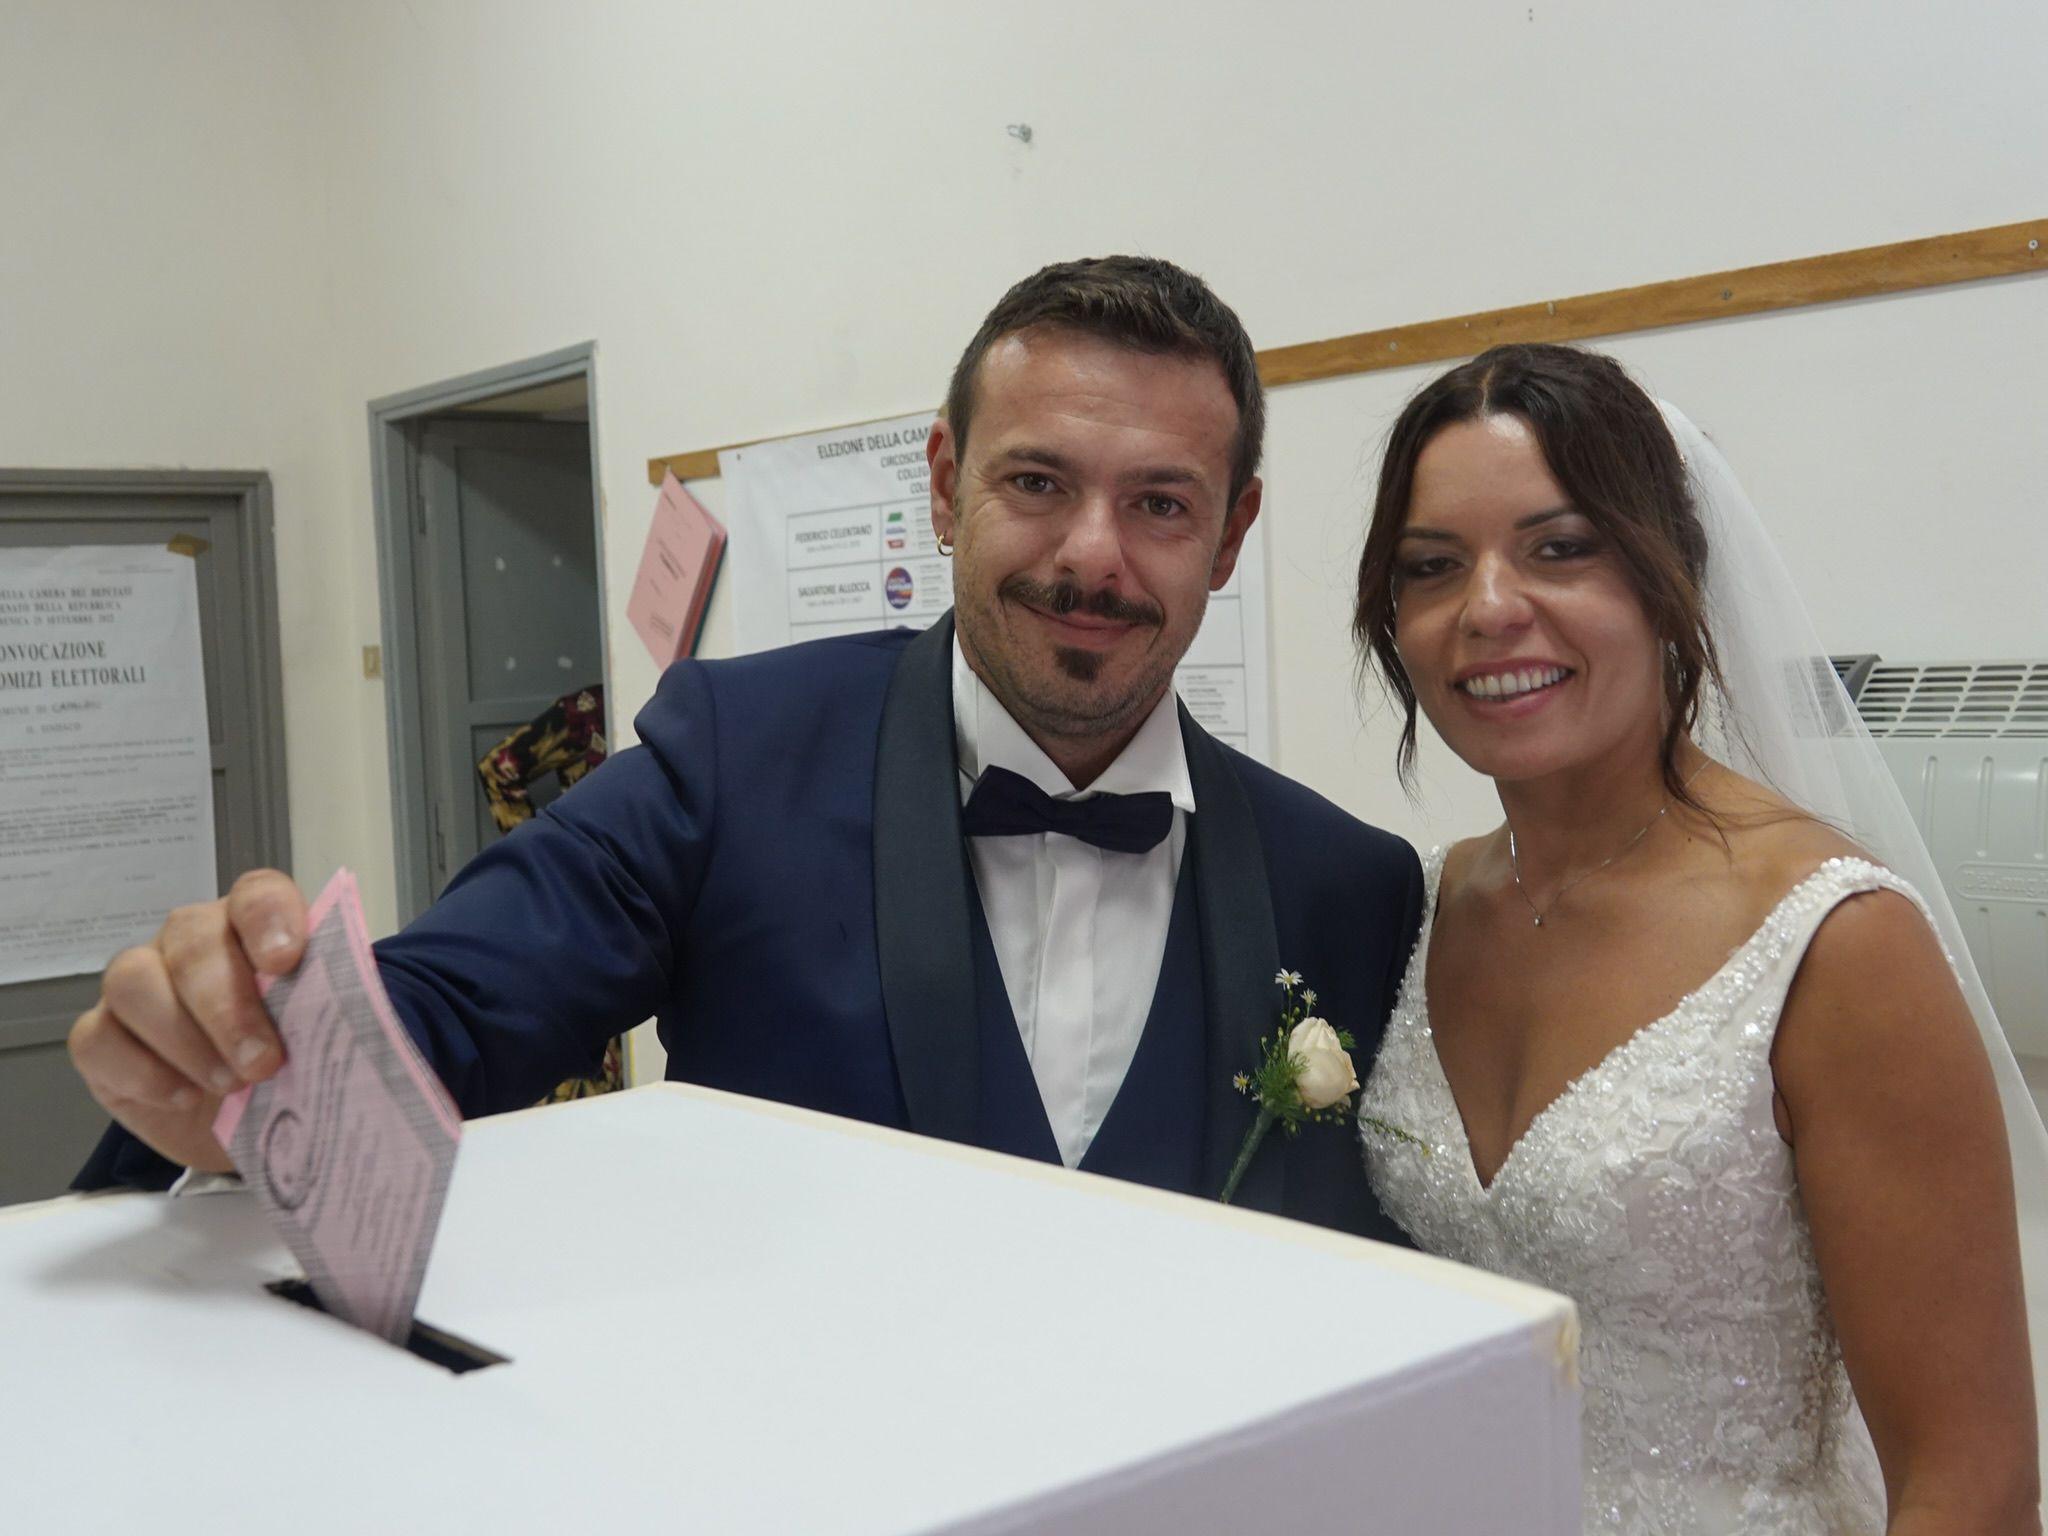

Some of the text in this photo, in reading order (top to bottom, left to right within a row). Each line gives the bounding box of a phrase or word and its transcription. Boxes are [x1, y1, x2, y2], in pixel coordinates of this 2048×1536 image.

[817, 437, 866, 460] ELEZIONE
[867, 432, 902, 451] DELLA
[795, 530, 829, 545] FEDERICO
[798, 584, 836, 598] SALVATORE
[838, 581, 871, 595] ALLOCCA
[51, 665, 146, 688] ELETTORALI
